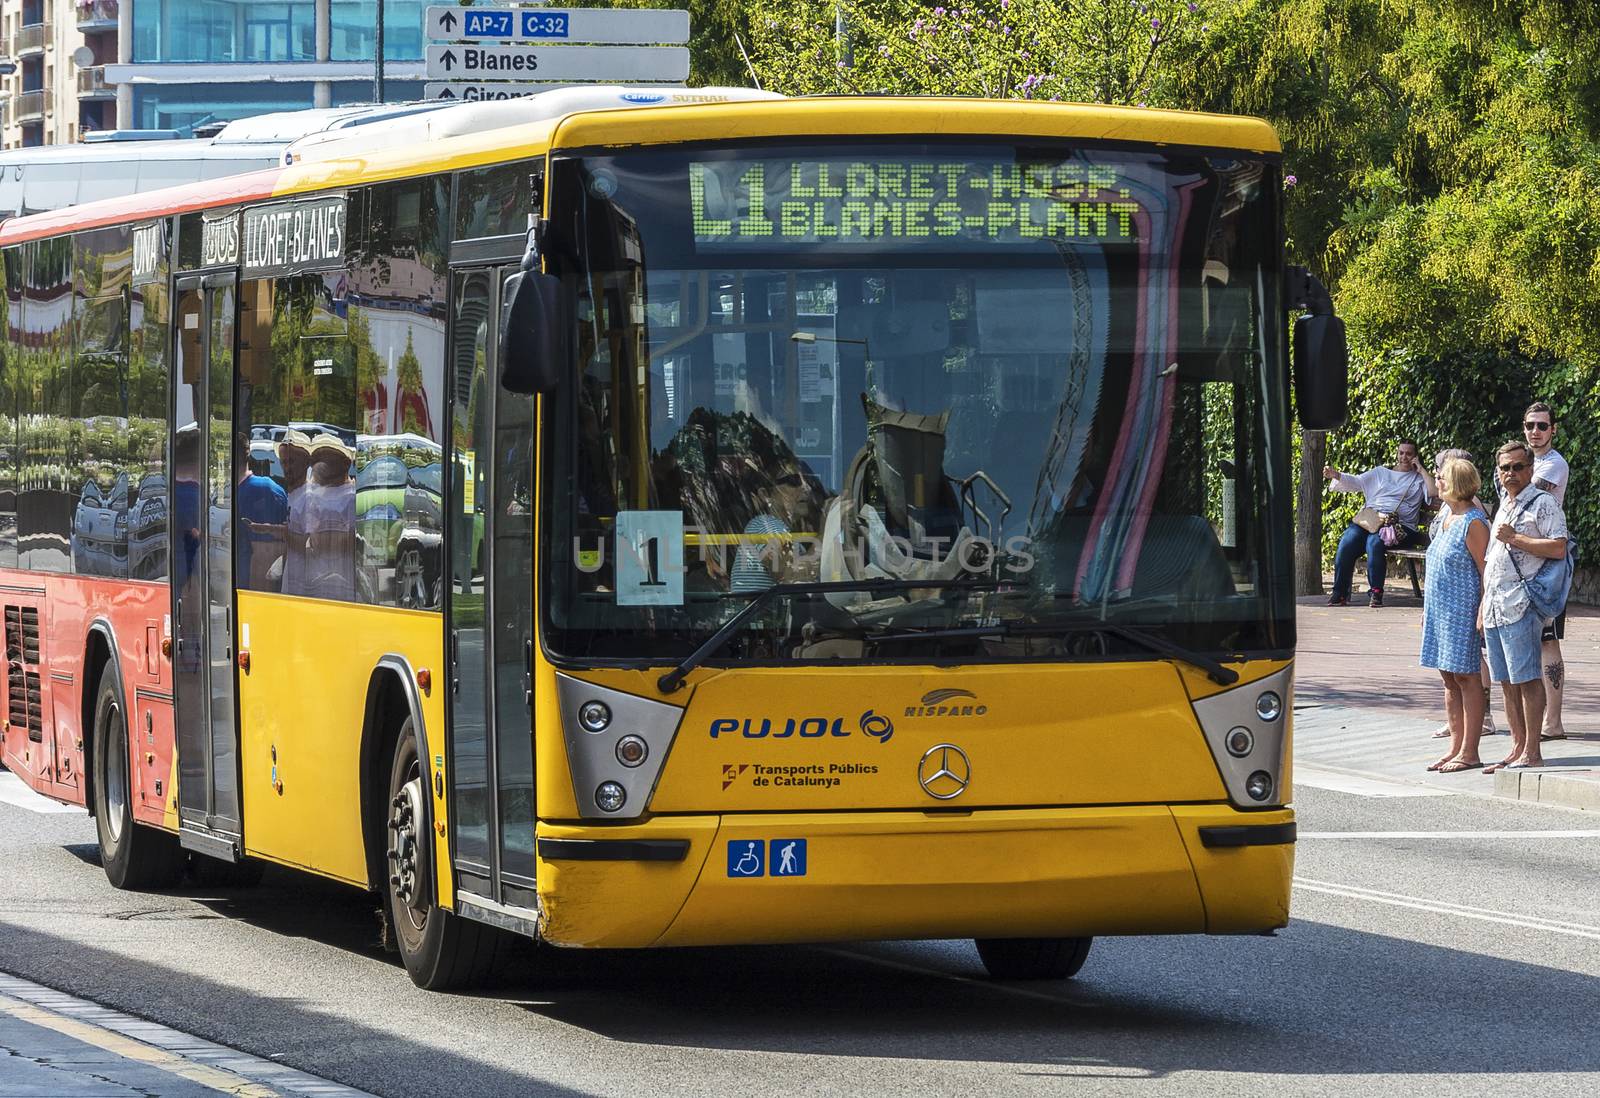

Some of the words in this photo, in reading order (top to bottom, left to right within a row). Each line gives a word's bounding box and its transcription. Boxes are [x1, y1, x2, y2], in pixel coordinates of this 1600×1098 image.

[469, 17, 508, 33] AP-7
[526, 17, 565, 33] C-32
[464, 50, 538, 70] Blanes
[790, 164, 1131, 198] LLORET-HOSP.
[689, 163, 773, 236] L1
[246, 205, 342, 267] LLORET-BLANES
[639, 537, 666, 586] 1
[904, 705, 987, 717] HISPANO
[709, 717, 851, 739] PUJOL
[753, 764, 824, 775] Transports
[829, 762, 878, 774] Públics
[753, 777, 769, 786] de
[774, 777, 841, 788] Catalunya
